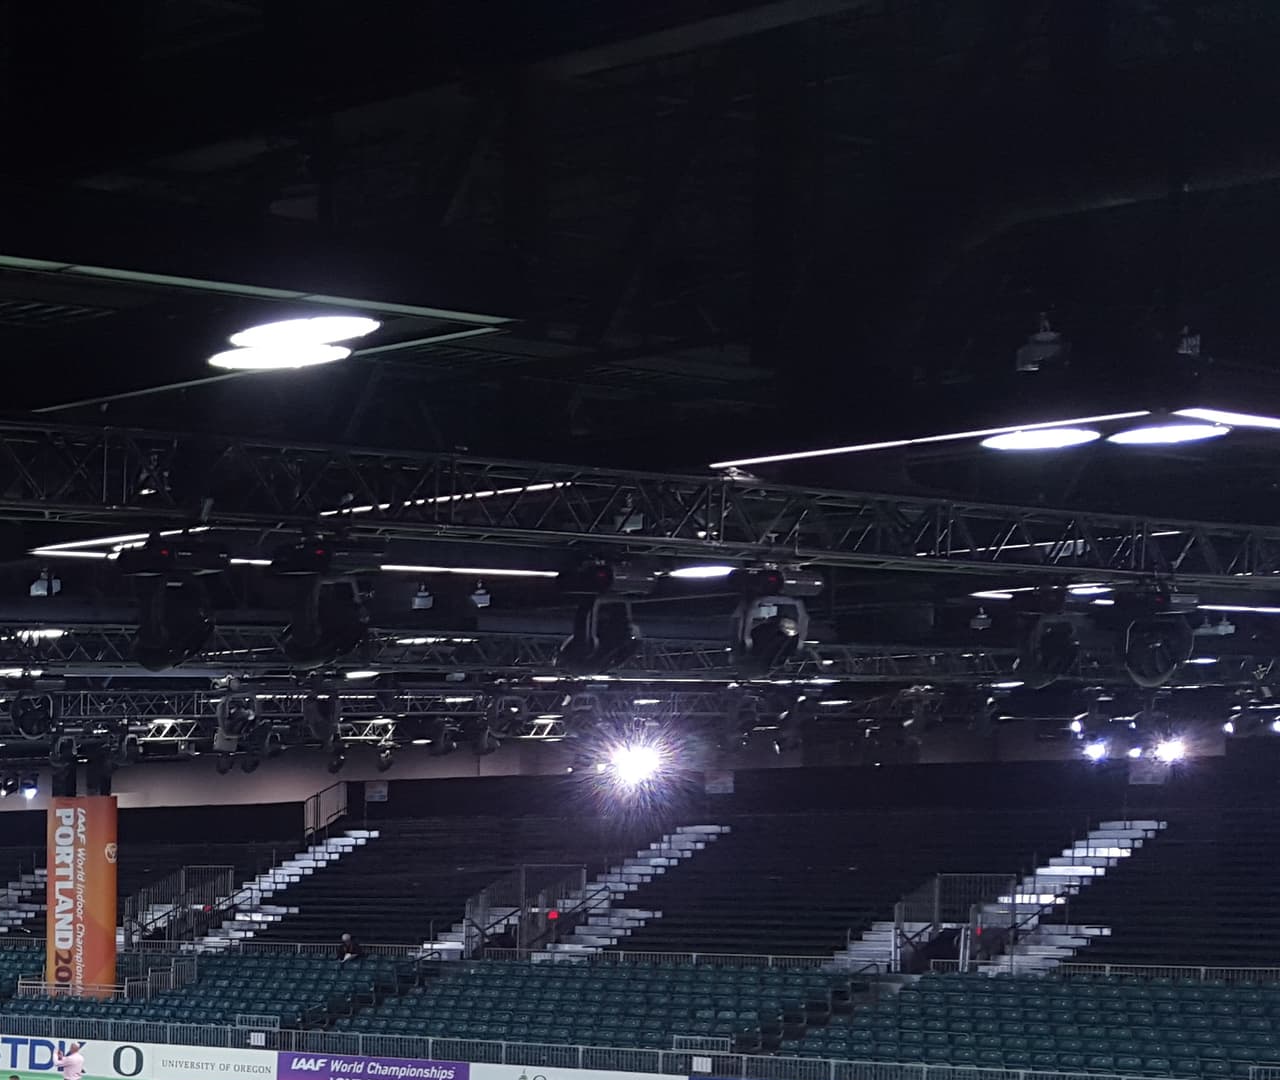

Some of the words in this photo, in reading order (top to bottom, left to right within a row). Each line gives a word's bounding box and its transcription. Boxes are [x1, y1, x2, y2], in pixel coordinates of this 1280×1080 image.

[161, 1059, 216, 1071] UNIVERSITY
[218, 1062, 231, 1072] OF
[233, 1063, 272, 1075] OREGON
[291, 1057, 327, 1072] IAAF
[330, 1059, 364, 1074] World
[367, 1062, 456, 1080] Championships
